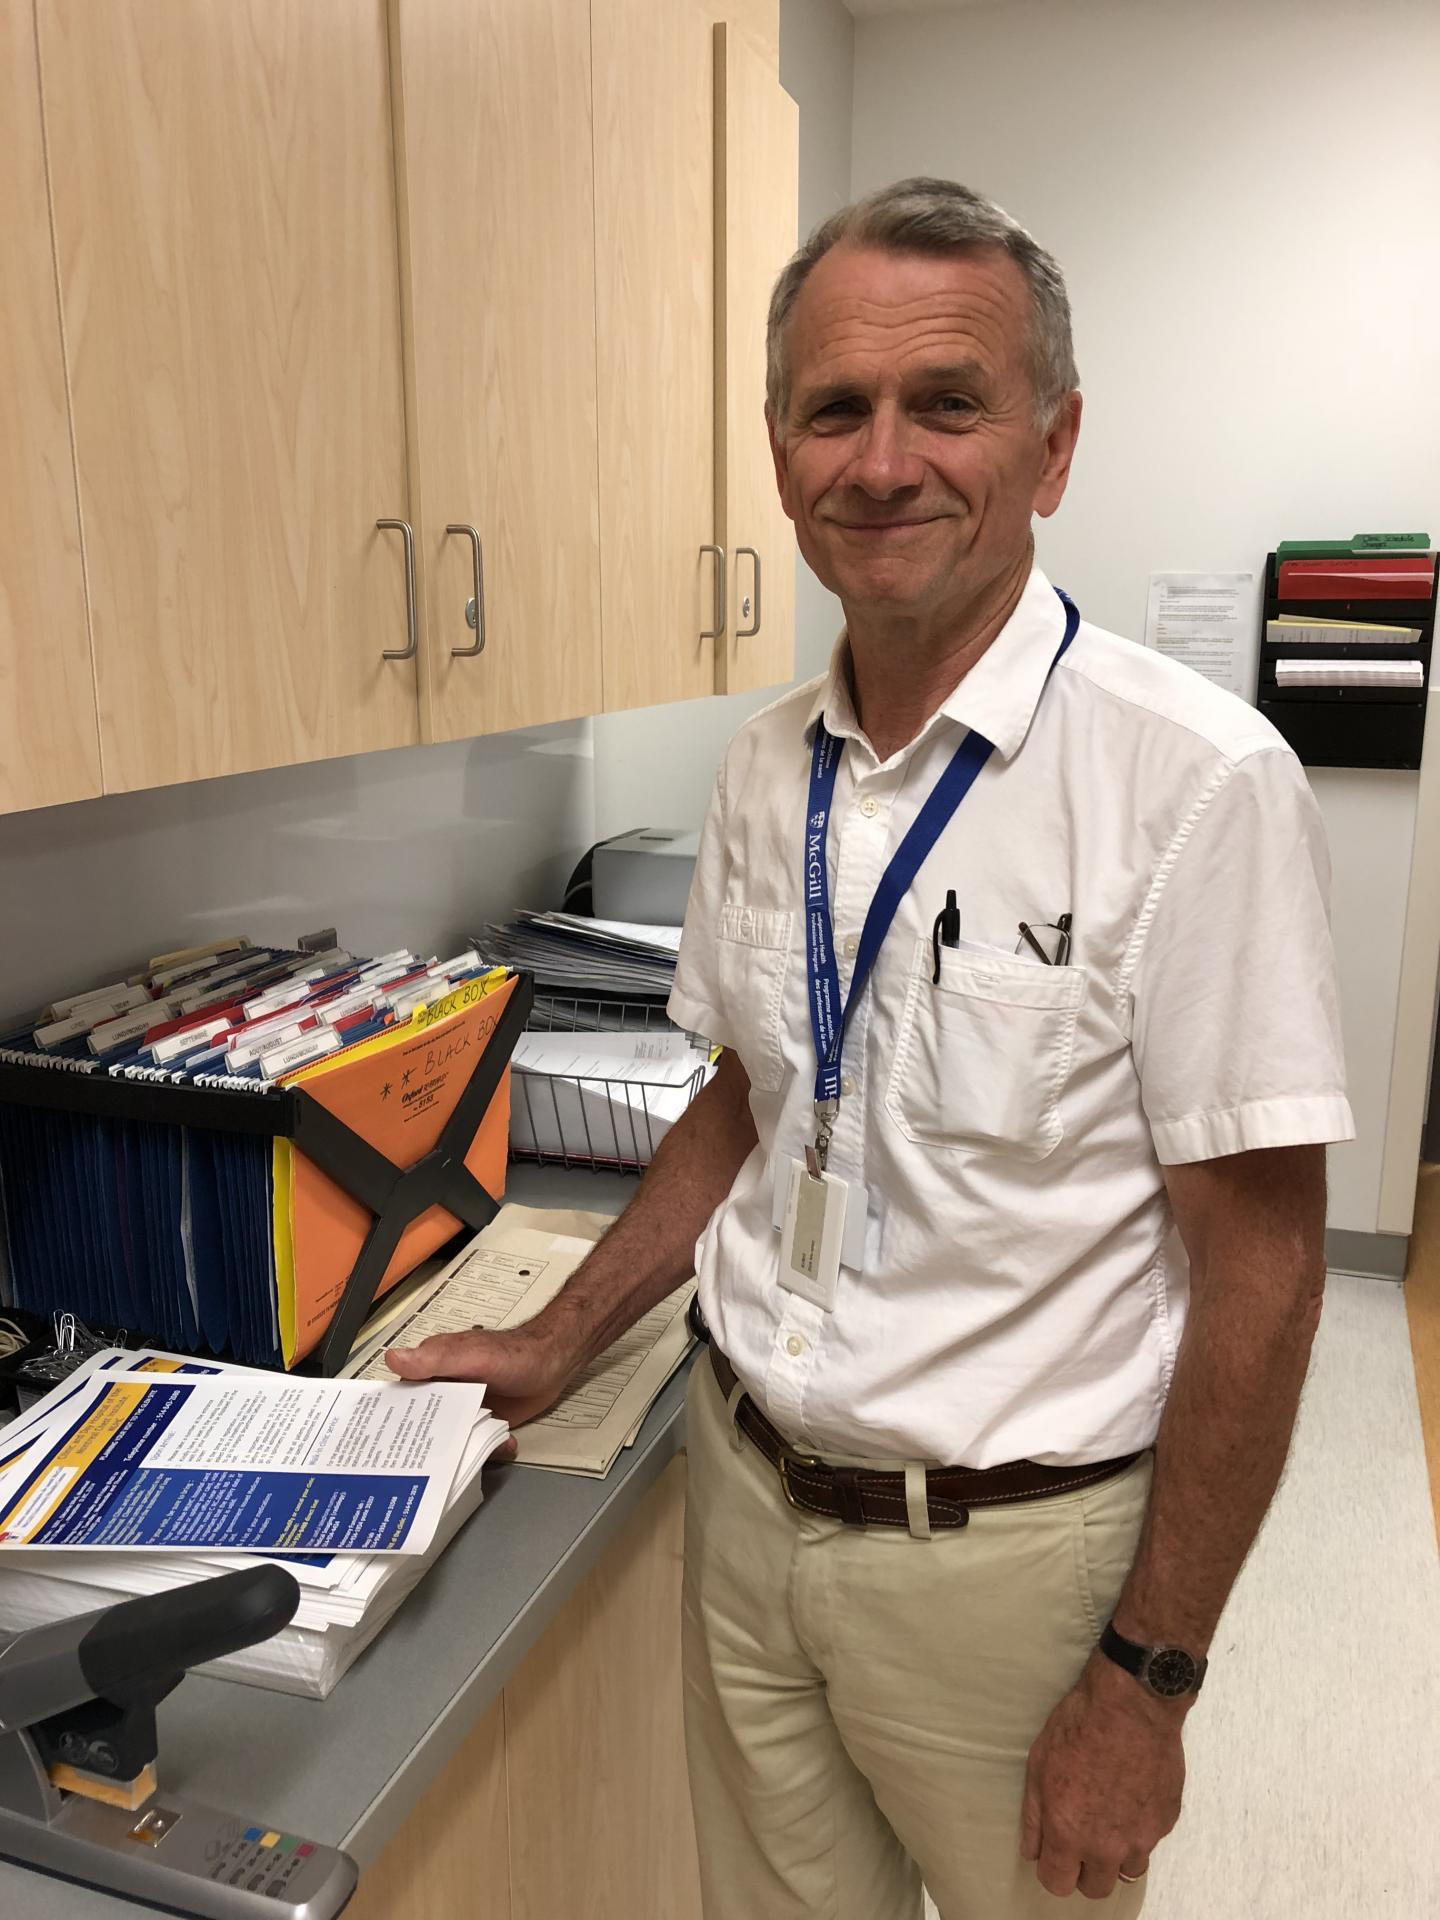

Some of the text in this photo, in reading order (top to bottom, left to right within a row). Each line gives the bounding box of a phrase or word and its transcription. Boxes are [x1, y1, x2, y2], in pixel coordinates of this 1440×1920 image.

[808, 834, 822, 900] McGill
[426, 995, 457, 1026] BLACK
[463, 976, 490, 1004] BOX
[823, 978, 831, 1012] Programme
[424, 1035, 471, 1076] BLACK
[123, 1439, 147, 1461] Telephone
[140, 1423, 158, 1438] number
